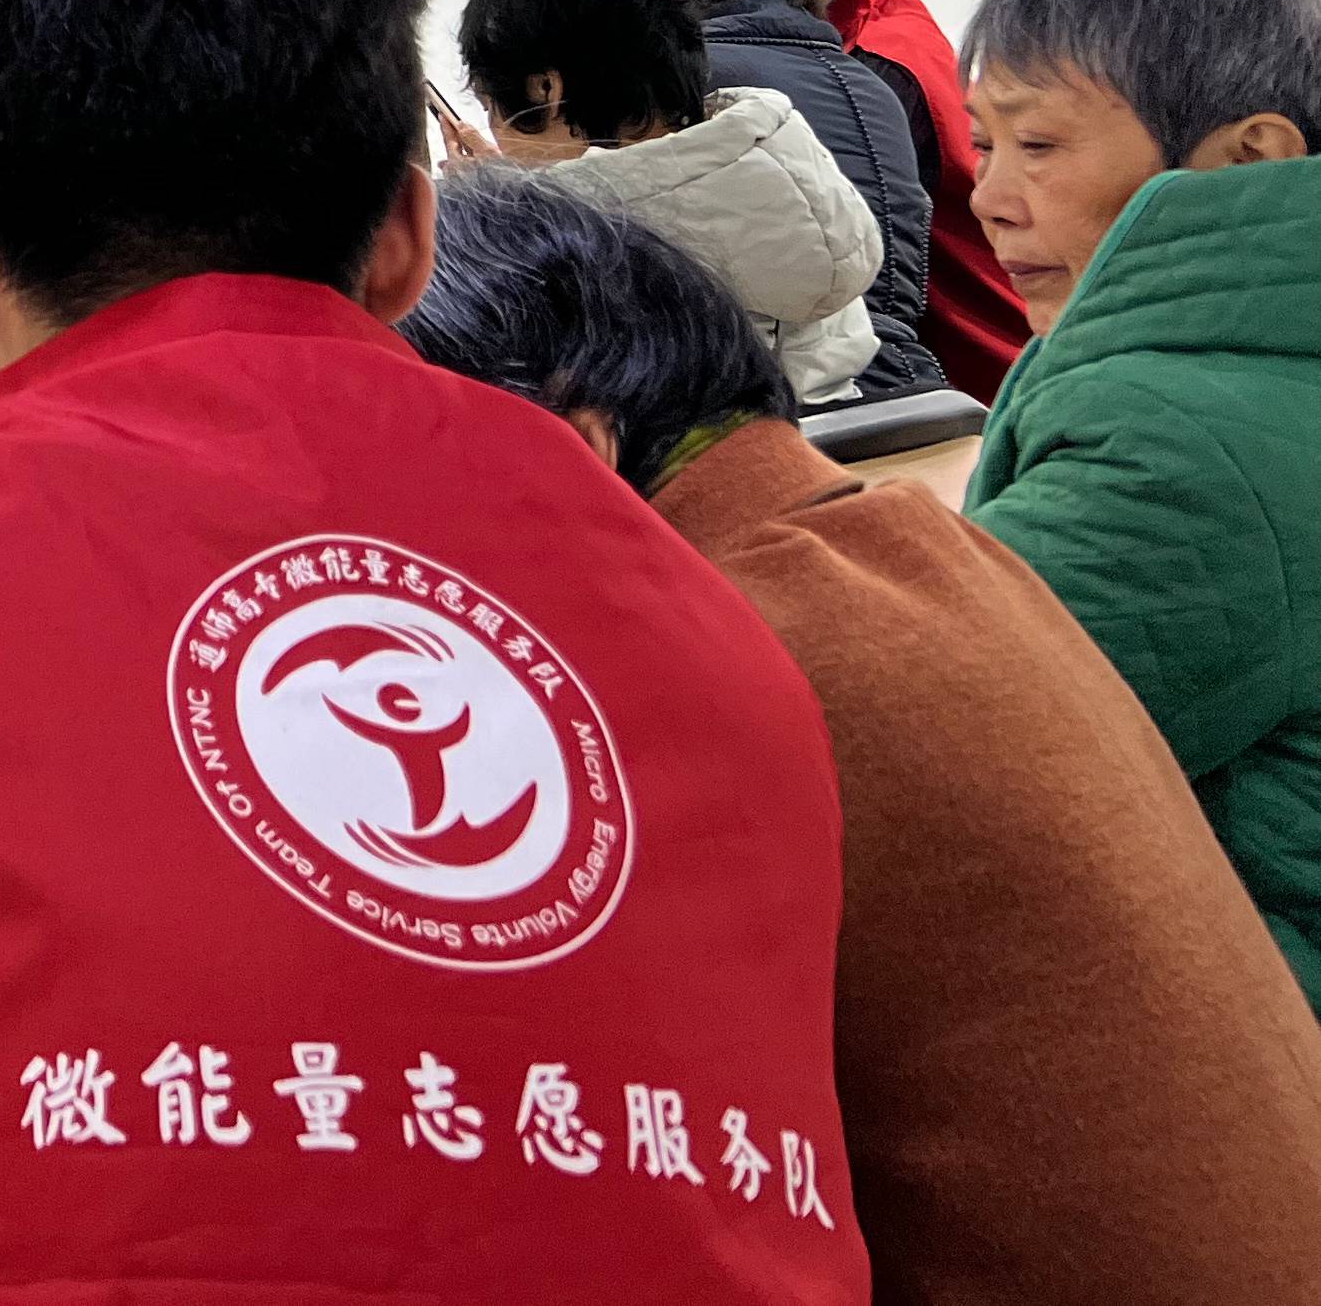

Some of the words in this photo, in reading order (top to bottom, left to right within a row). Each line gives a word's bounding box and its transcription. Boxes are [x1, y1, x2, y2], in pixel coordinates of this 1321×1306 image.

[186, 687, 228, 773] NTNC
[571, 719, 609, 804] Micro
[255, 818, 333, 900] Team
[567, 817, 617, 905] Energy
[345, 889, 463, 949] Service
[471, 898, 580, 948] Volunte
[19, 1040, 835, 1231] 微能量志愿服务队
